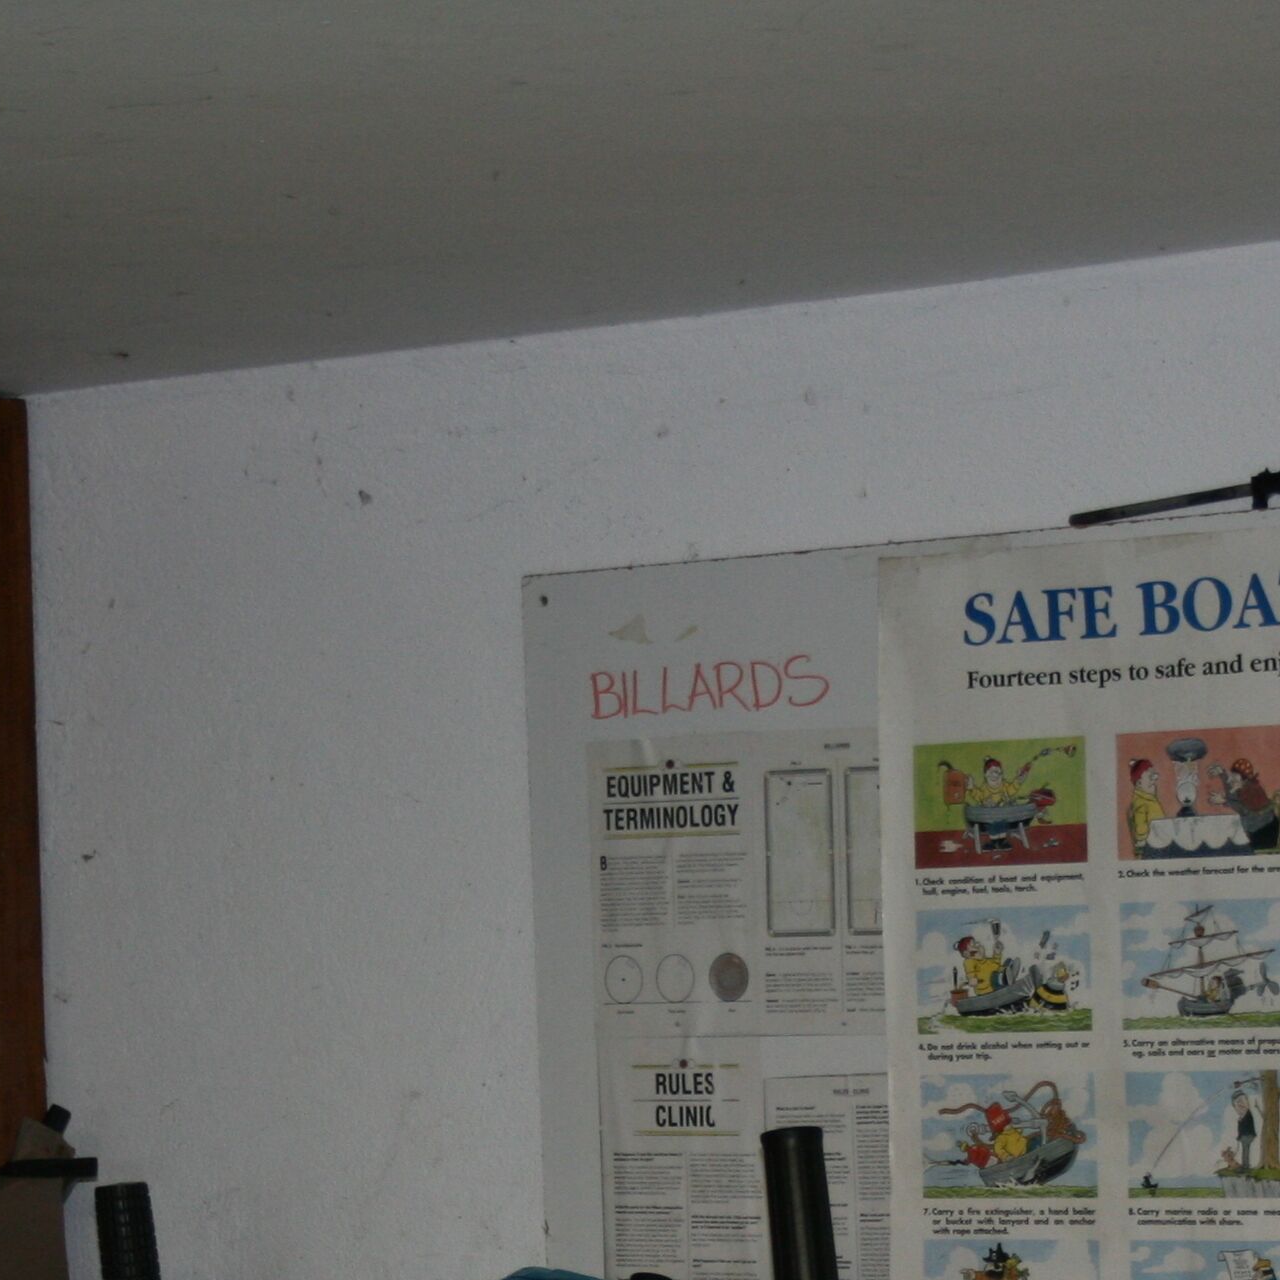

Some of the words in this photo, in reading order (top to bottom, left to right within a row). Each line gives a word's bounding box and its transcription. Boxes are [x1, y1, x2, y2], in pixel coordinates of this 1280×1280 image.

[963, 585, 1118, 646] SAFE
[967, 671, 1061, 688] Fourteen
[1069, 668, 1121, 687] steps
[1128, 665, 1148, 680] to
[1155, 658, 1195, 678] safe
[1202, 654, 1242, 675] and
[590, 654, 830, 720] BILLARDS
[606, 771, 716, 798] EQUIPMENT
[722, 772, 735, 794] &
[603, 804, 740, 831] TERMINOLOGY
[1131, 1039, 1154, 1047] Carry
[928, 1052, 953, 1061] during
[656, 1072, 714, 1095] RULES
[656, 1105, 716, 1128] CLINIC
[998, 1217, 1029, 1226] lanyard
[1136, 1207, 1159, 1216] Carry
